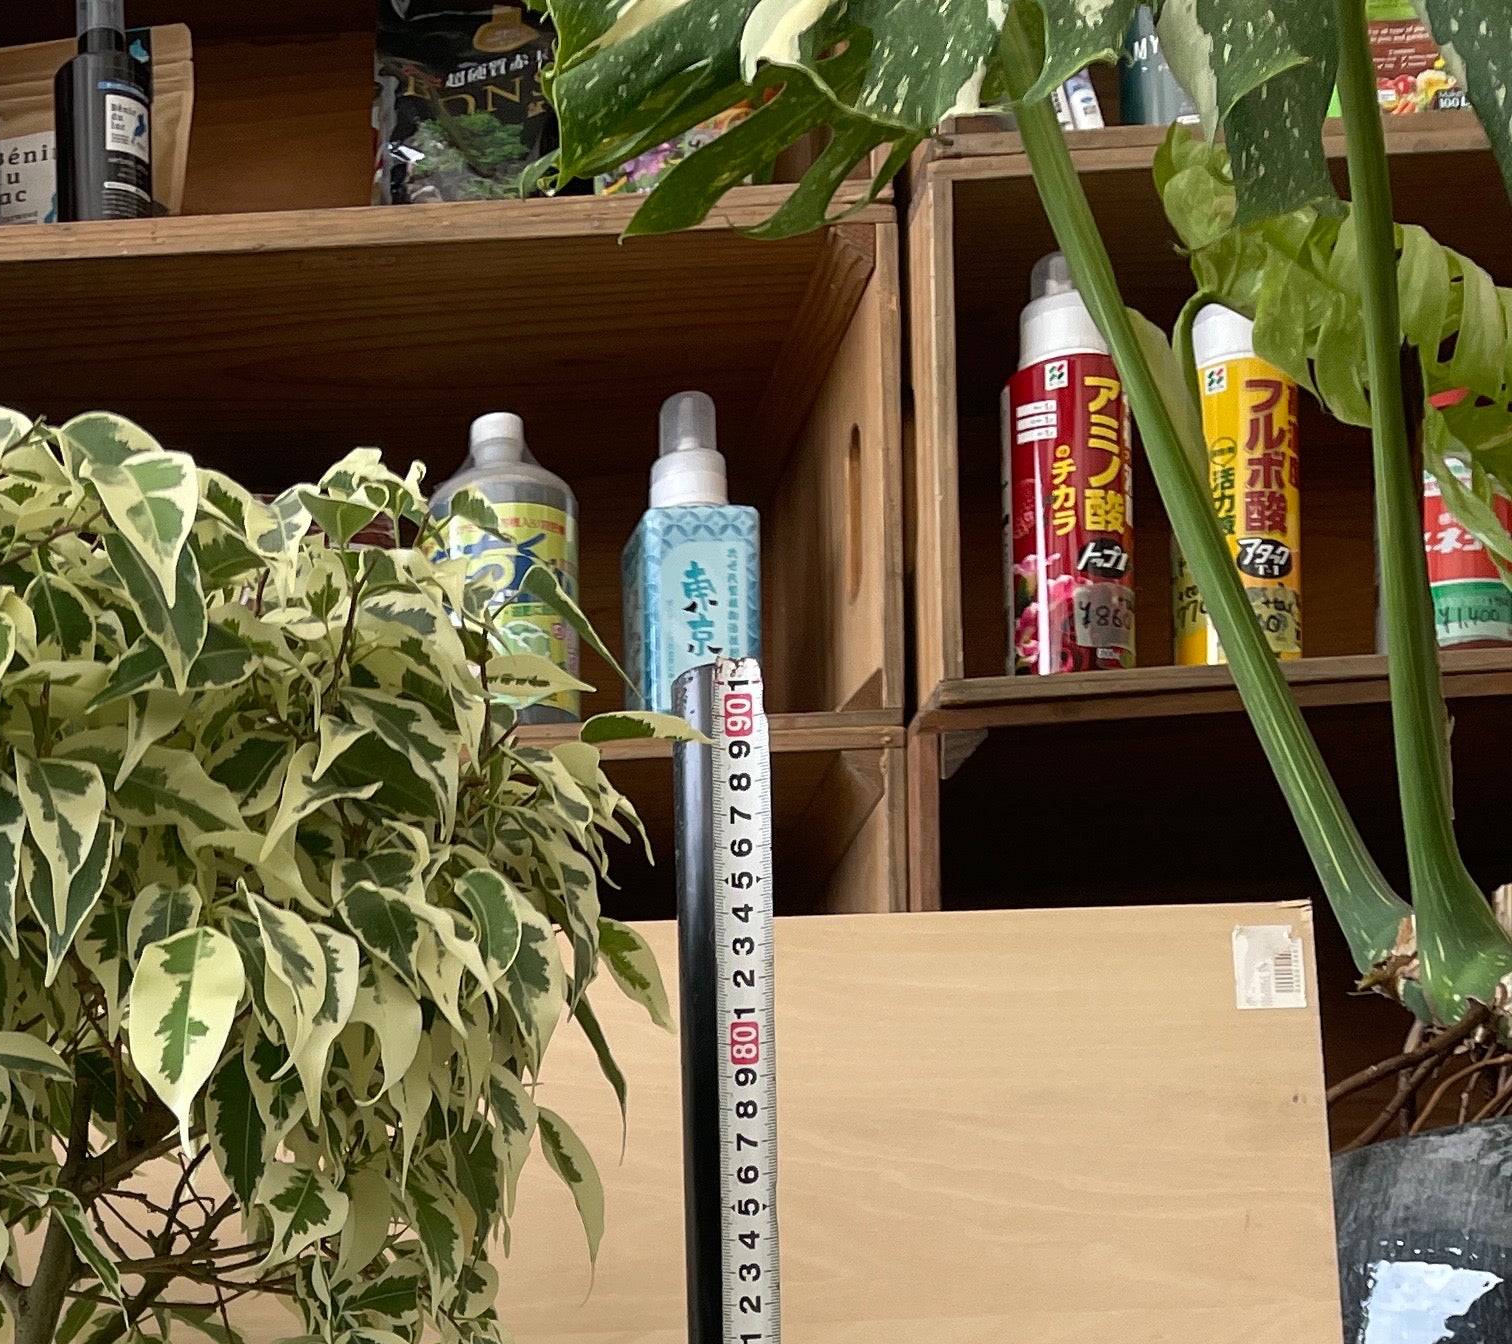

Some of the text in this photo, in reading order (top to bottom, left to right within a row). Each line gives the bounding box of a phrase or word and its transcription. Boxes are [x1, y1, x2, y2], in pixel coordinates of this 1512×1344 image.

[1083, 376, 1126, 534] アミノ酸
[1244, 379, 1288, 534] フルボ酸
[727, 679, 749, 692] 1
[726, 696, 750, 733] 90
[728, 740, 751, 759] 9
[728, 772, 751, 792] 8
[729, 805, 752, 825] 7
[730, 838, 753, 858] 6
[731, 871, 753, 890] 5
[731, 903, 754, 923] 4
[732, 936, 755, 956] 3
[732, 969, 755, 988] 2
[733, 1007, 756, 1020] 1
[733, 1024, 757, 1062] 80
[734, 1067, 757, 1087] 9
[735, 1099, 758, 1119] 8
[736, 1133, 758, 1152] 7
[736, 1165, 759, 1185] 6
[737, 1198, 760, 1217] 5
[738, 1230, 760, 1250] 4
[738, 1263, 761, 1282] 3
[739, 1295, 762, 1314] 2
